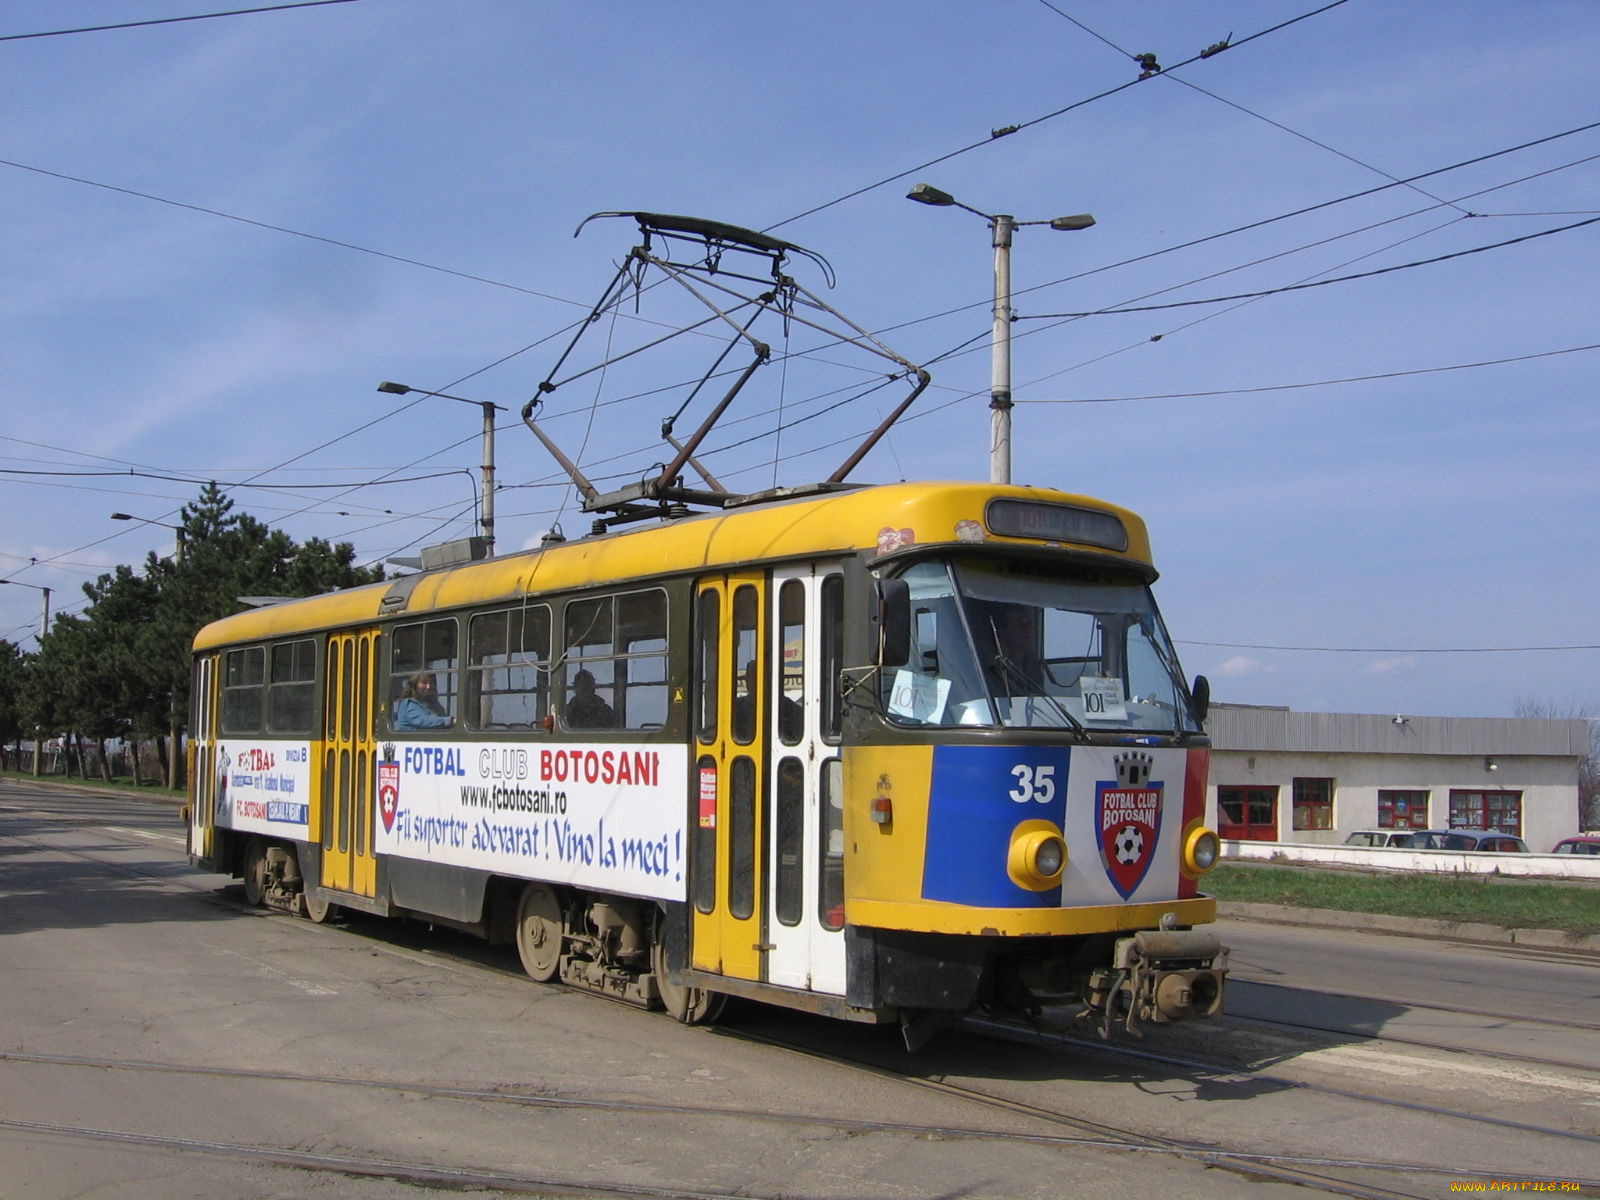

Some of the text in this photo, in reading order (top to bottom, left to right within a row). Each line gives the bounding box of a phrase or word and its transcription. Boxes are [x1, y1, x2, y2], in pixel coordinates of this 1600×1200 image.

[1084, 693, 1105, 713] 101
[301, 747, 307, 762] B
[404, 747, 659, 786] FOTBAL CLUB BOTOSANI
[460, 781, 567, 815] www.fcbotosani.ro
[1009, 765, 1055, 804] 35
[1104, 792, 1157, 809] FOTBAL CLUB
[1103, 808, 1155, 831] BOTOSANI
[396, 808, 411, 846] Fii
[413, 813, 468, 853] suporter
[472, 816, 539, 858] adevarat
[553, 817, 594, 866] Vino
[598, 816, 617, 869] la
[621, 833, 670, 878] meci
